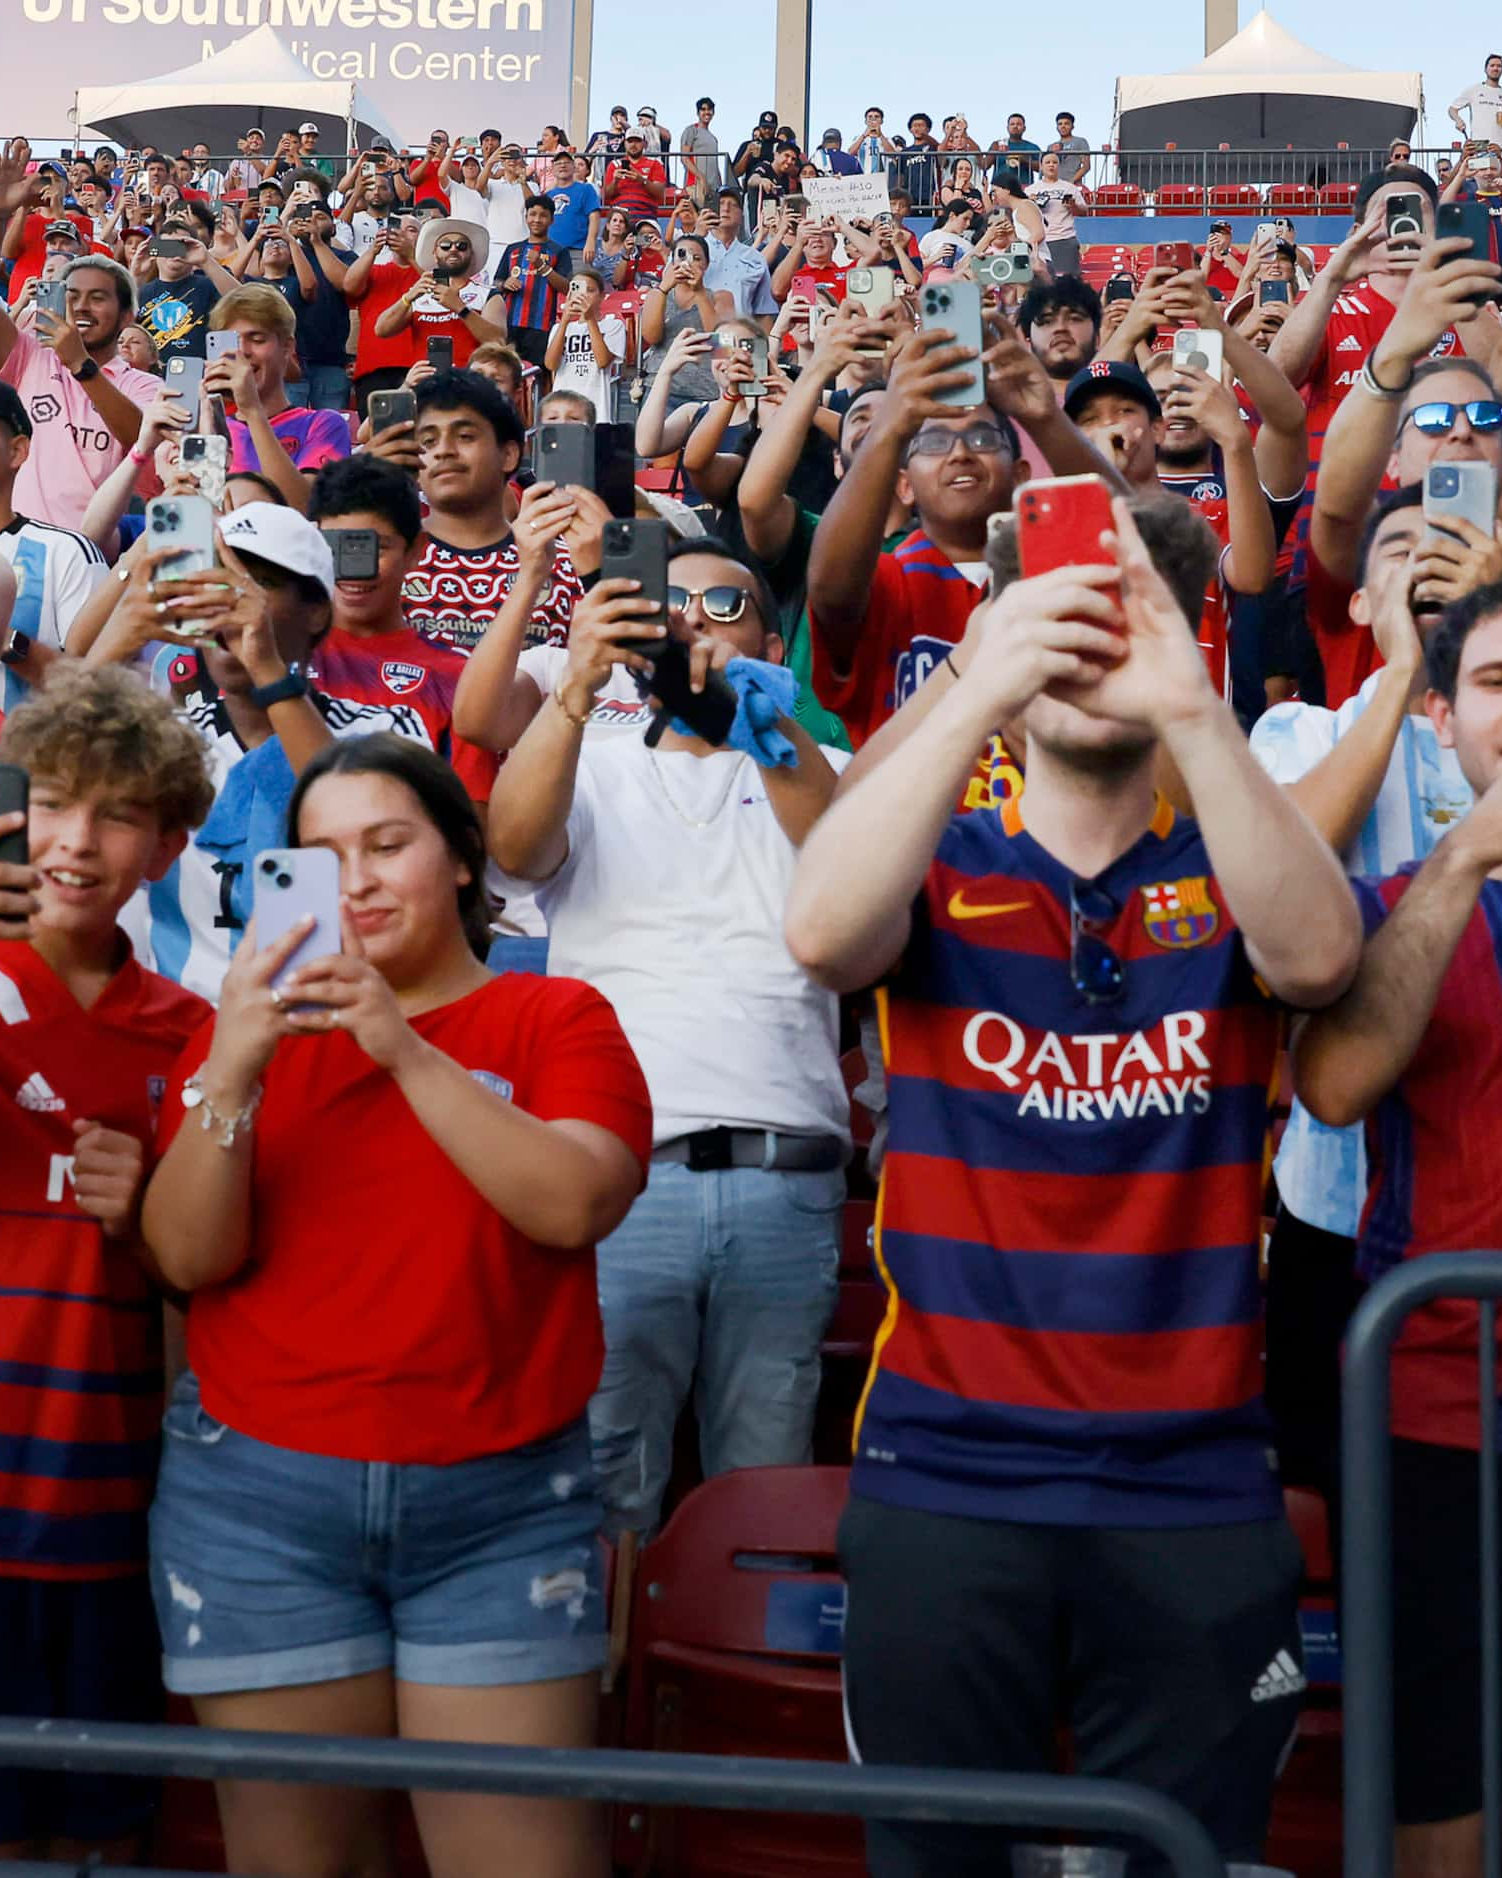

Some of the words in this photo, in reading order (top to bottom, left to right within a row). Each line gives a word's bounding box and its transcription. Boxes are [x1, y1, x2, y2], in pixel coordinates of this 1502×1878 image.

[388, 48, 541, 83] Center
[962, 1008, 1211, 1087] QATAR
[1017, 1073, 1212, 1122] AIRWAYS
